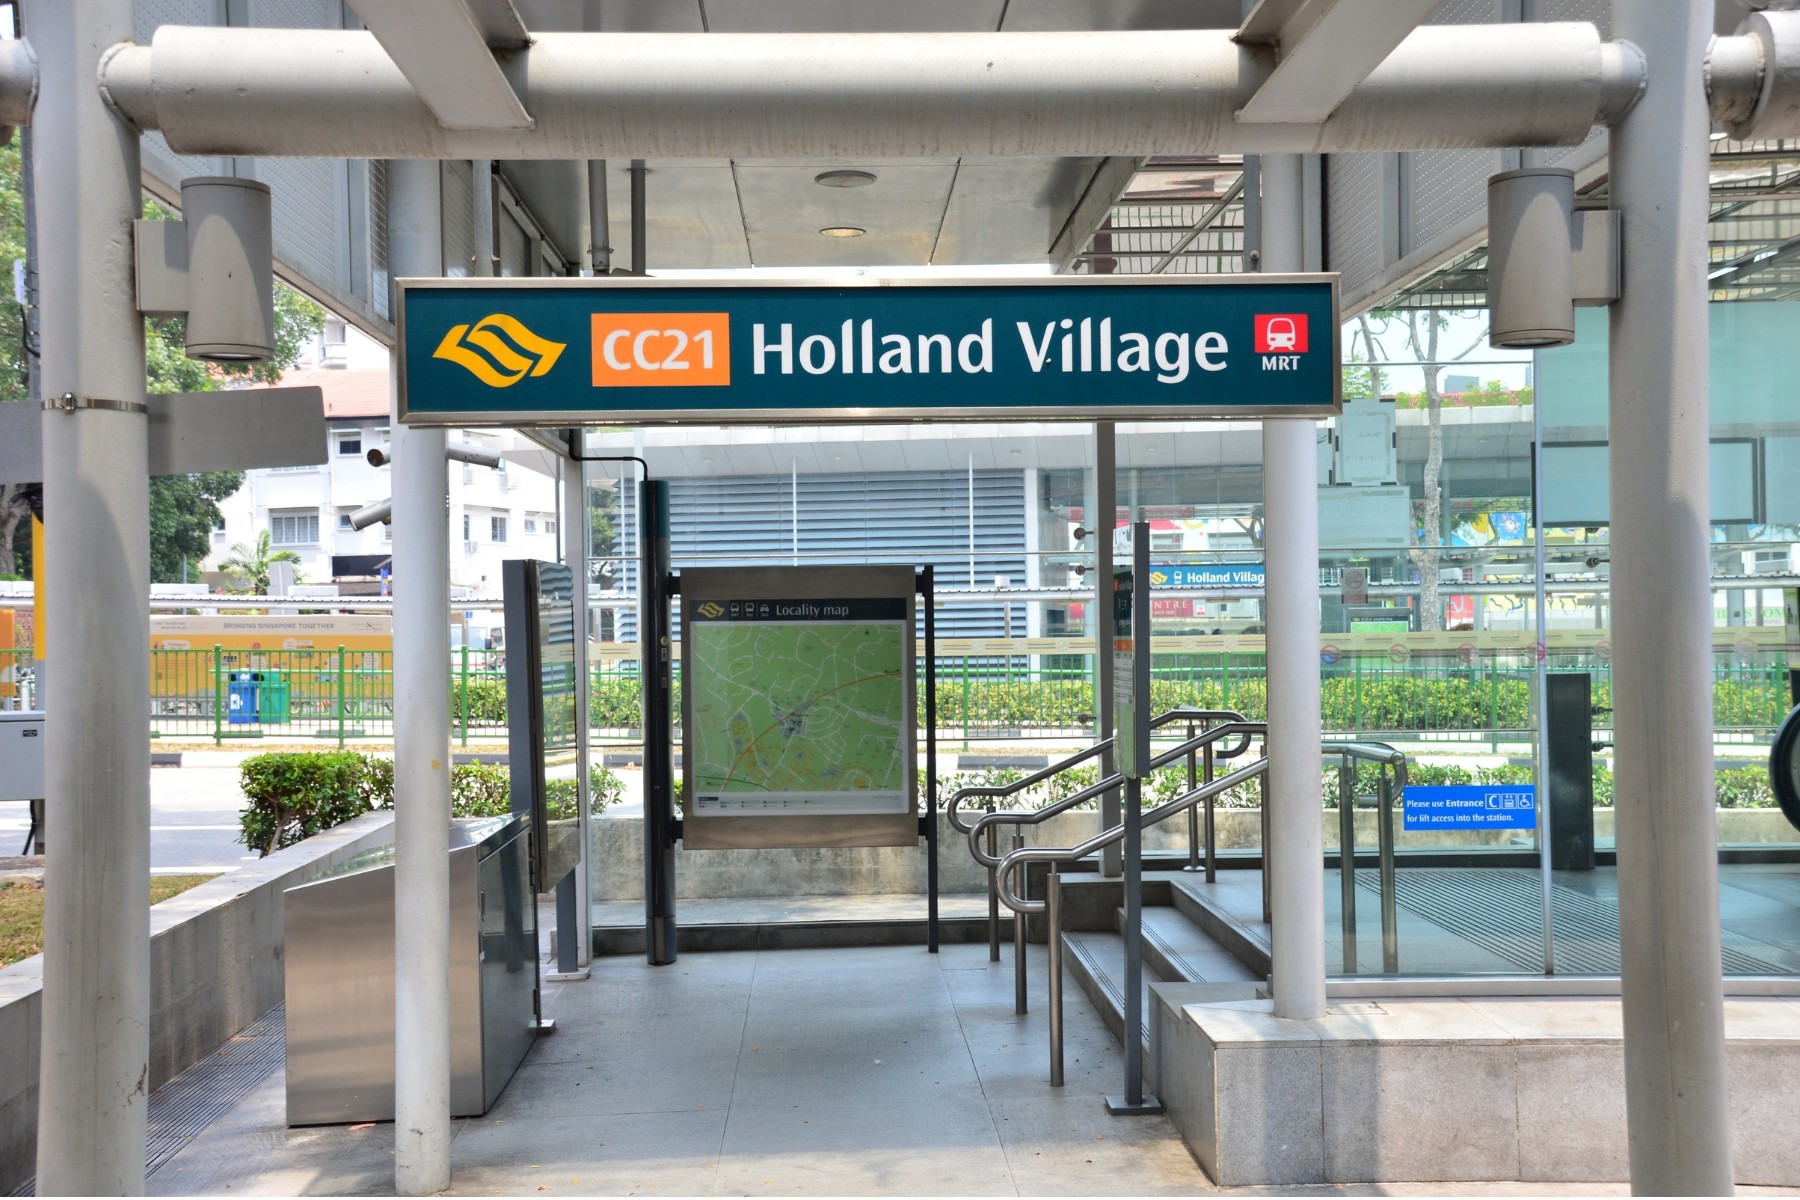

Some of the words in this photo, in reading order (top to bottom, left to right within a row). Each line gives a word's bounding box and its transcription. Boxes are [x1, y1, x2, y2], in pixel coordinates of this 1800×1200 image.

[602, 328, 714, 371] CC21
[752, 317, 993, 375] Holland
[1016, 316, 1229, 384] Village
[1262, 356, 1301, 371] MRT
[1187, 571, 1230, 583] Holland
[1233, 571, 1265, 584] Villag
[776, 604, 820, 618] Locality
[823, 605, 849, 617] map
[1154, 600, 1187, 609] NTRE
[1406, 799, 1430, 808] Please
[1431, 800, 1444, 808] use
[1446, 799, 1484, 808] Entrance
[1406, 814, 1418, 823] for
[1419, 813, 1430, 823] lift
[1456, 813, 1471, 822] into
[1472, 813, 1485, 822] the
[1486, 813, 1514, 822] station.
